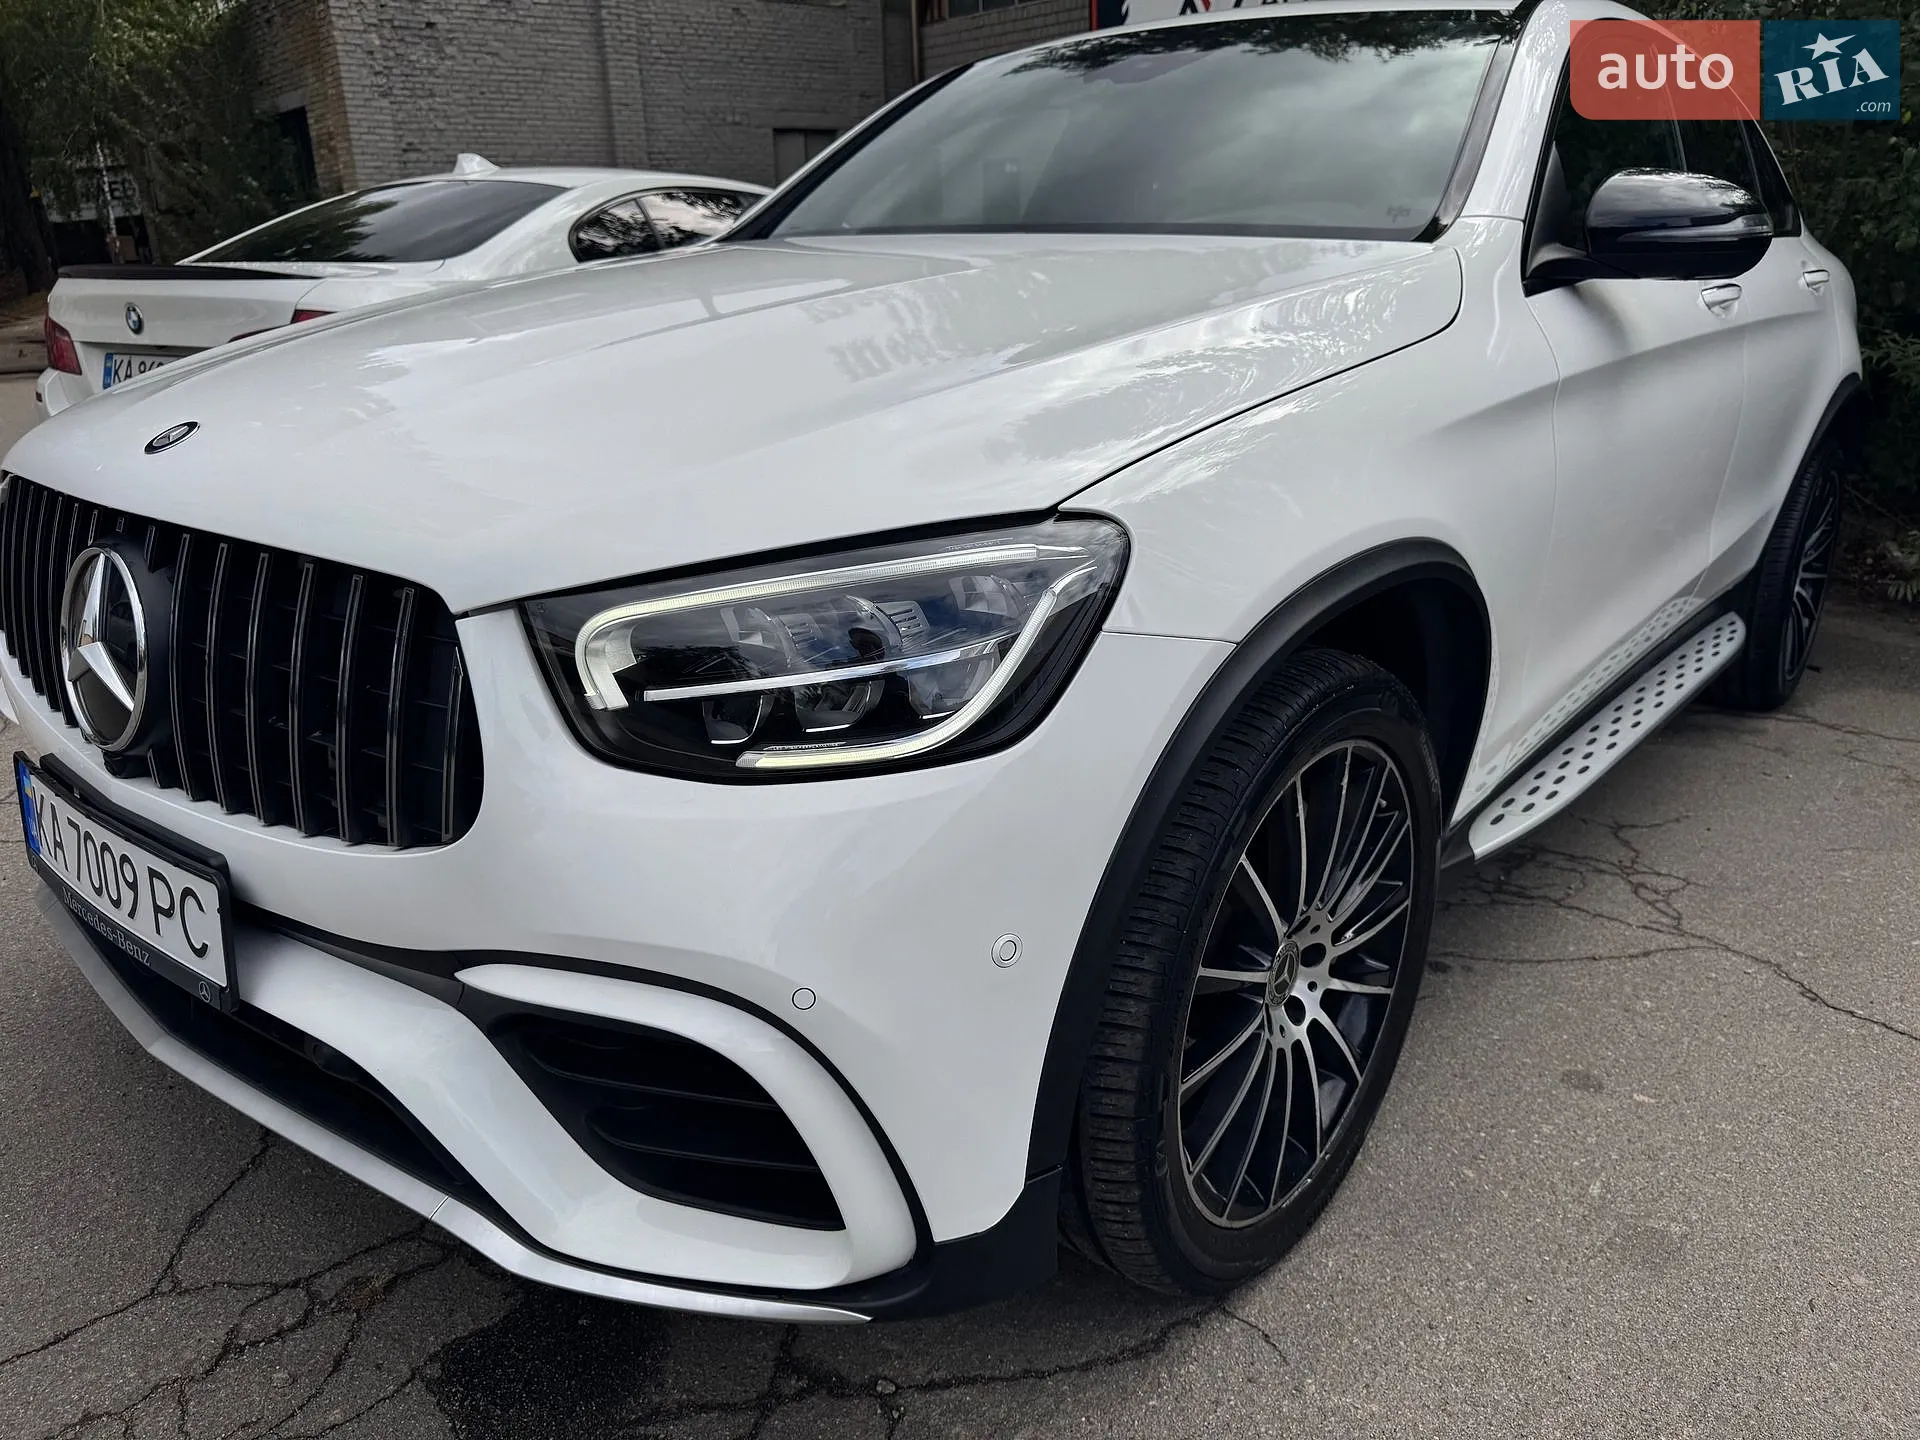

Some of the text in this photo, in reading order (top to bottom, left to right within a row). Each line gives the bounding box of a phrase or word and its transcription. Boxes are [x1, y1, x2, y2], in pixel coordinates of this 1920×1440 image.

[113, 358, 133, 384] KA
[33, 786, 209, 959] KA 7009 PC
[62, 886, 151, 966] Mercedes-Benz
